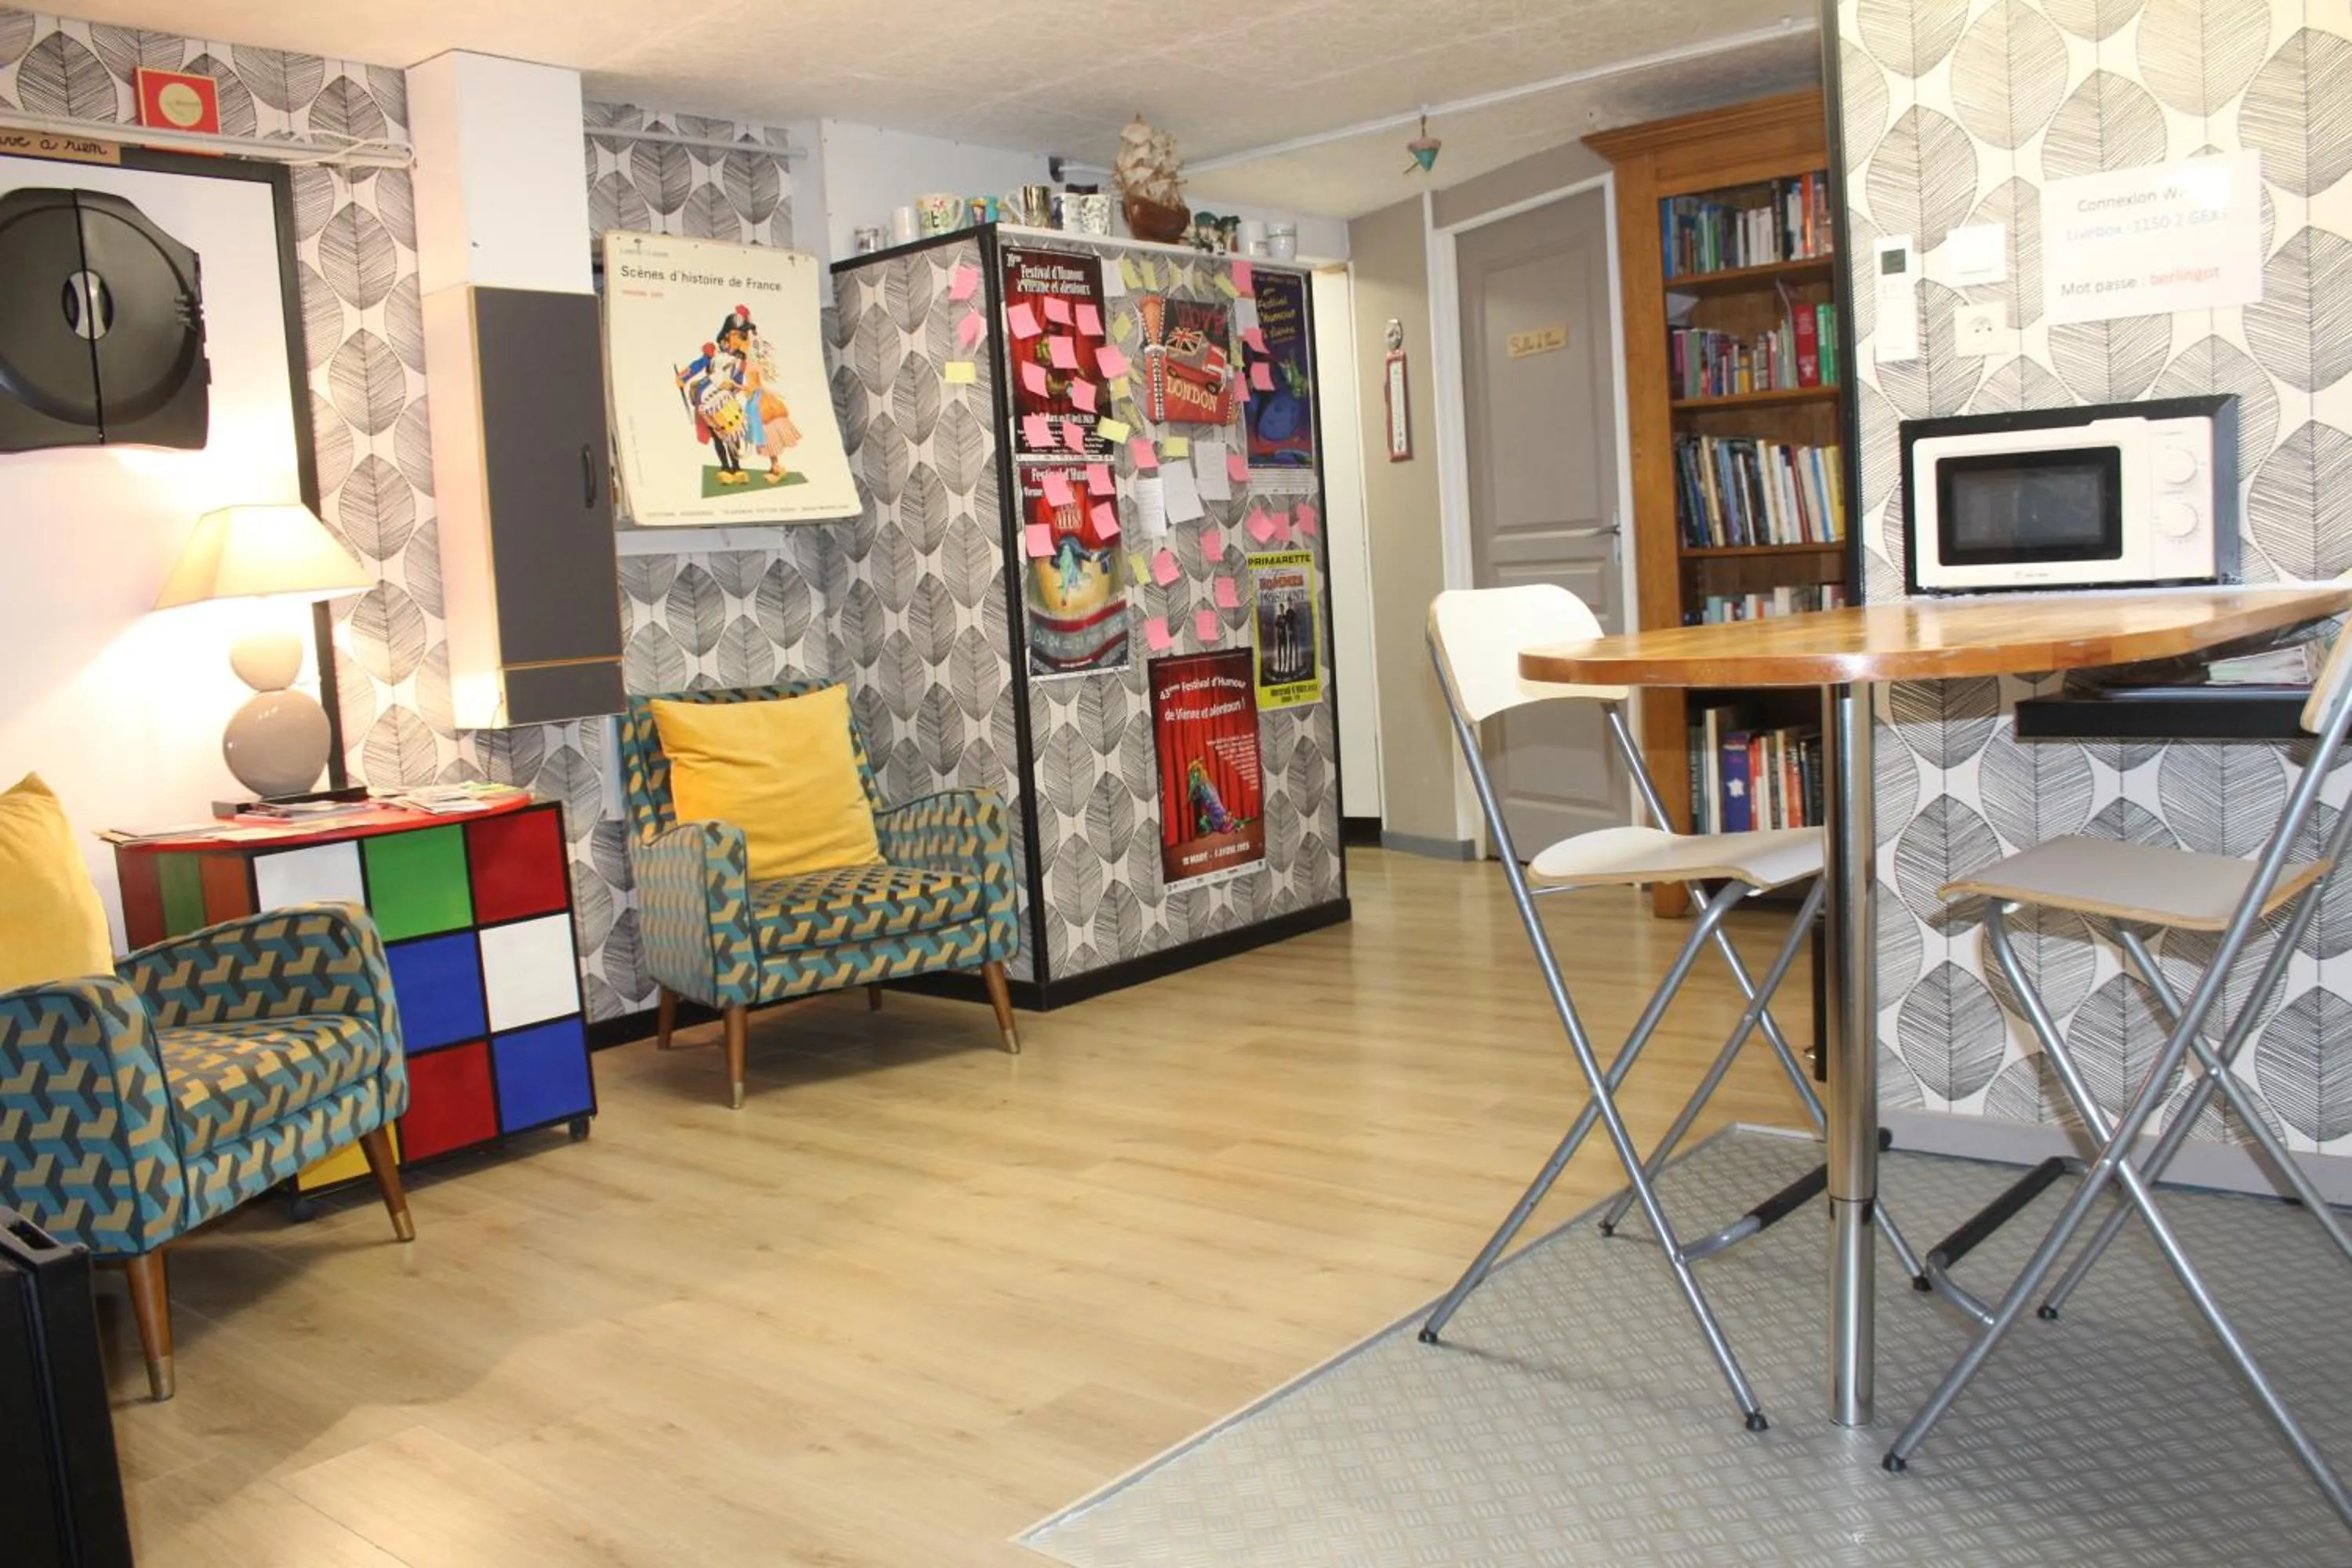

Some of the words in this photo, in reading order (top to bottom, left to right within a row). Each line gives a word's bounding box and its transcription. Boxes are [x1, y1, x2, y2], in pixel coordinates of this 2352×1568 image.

[2078, 191, 2158, 212] Connexion
[620, 265, 665, 281] Scènes
[670, 269, 724, 287] d'histoire
[728, 276, 742, 288] de
[746, 277, 782, 292] France
[2060, 281, 2092, 297] Mot
[2095, 276, 2138, 294] passe
[2149, 267, 2220, 287] berlingot
[1166, 376, 1218, 413] LONDON
[1247, 554, 1312, 565] PRIMARETTE
[1181, 677, 1210, 692] Festival
[1211, 675, 1247, 689] d'Humour
[1164, 706, 1175, 721] de
[1176, 706, 1200, 720] Vienne
